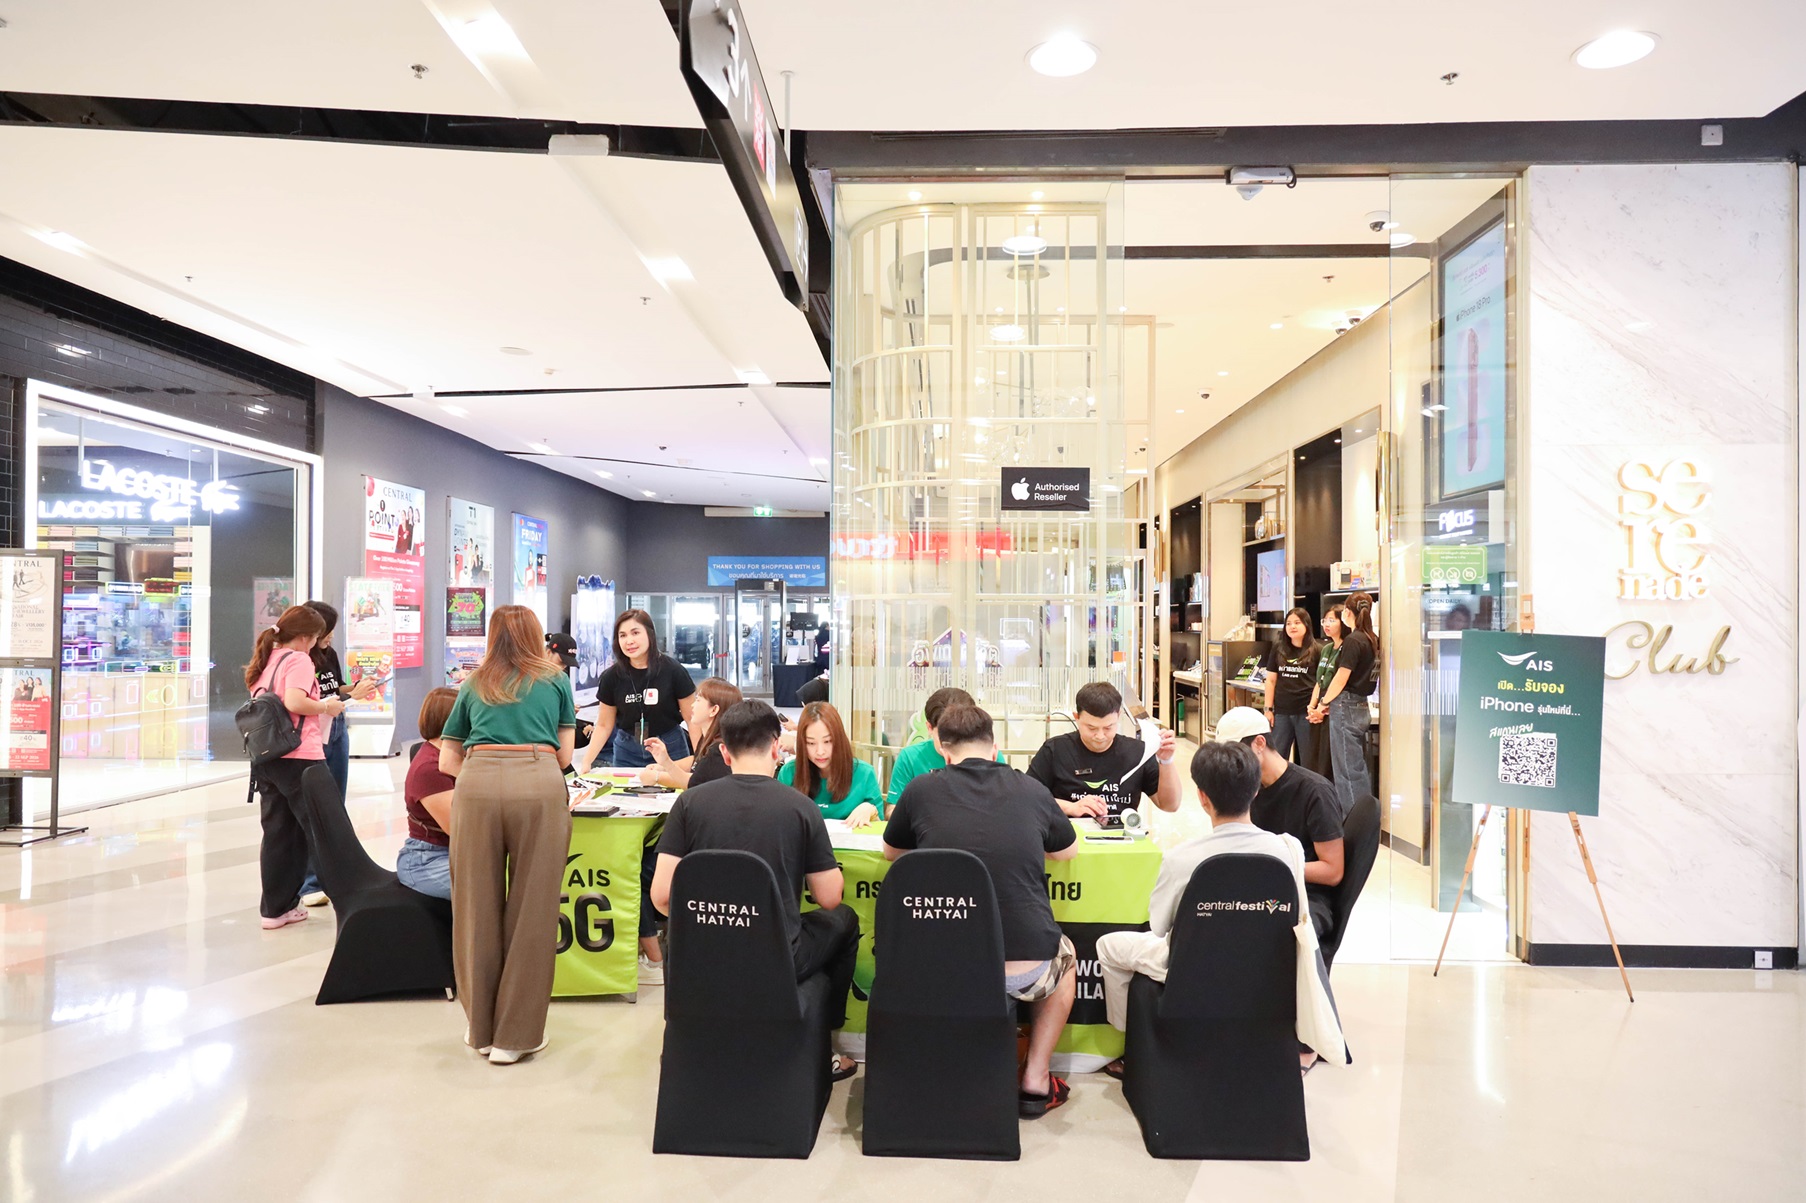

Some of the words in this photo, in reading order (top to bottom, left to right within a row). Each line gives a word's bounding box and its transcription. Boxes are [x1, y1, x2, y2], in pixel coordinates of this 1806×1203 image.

[383, 486, 413, 502] CENTRAL
[1034, 482, 1080, 491] Authorised
[1617, 457, 1712, 516] se
[1034, 492, 1067, 501] Reseller
[37, 500, 143, 518] LACOSTE
[521, 528, 543, 542] FRIDAY
[1617, 562, 1711, 601] nade
[1603, 620, 1740, 681] Club
[1526, 659, 1553, 672] AIS
[321, 671, 334, 680] AIS
[1497, 678, 1565, 694] เปิด...รับจอง
[1480, 696, 1534, 713] iPhone
[1102, 783, 1119, 792] AIS
[568, 868, 610, 888] AIS
[687, 900, 760, 916] CENTRAL
[902, 896, 977, 907] CENTRAL
[696, 913, 750, 927] HATYAI
[912, 909, 967, 919] HATYAI
